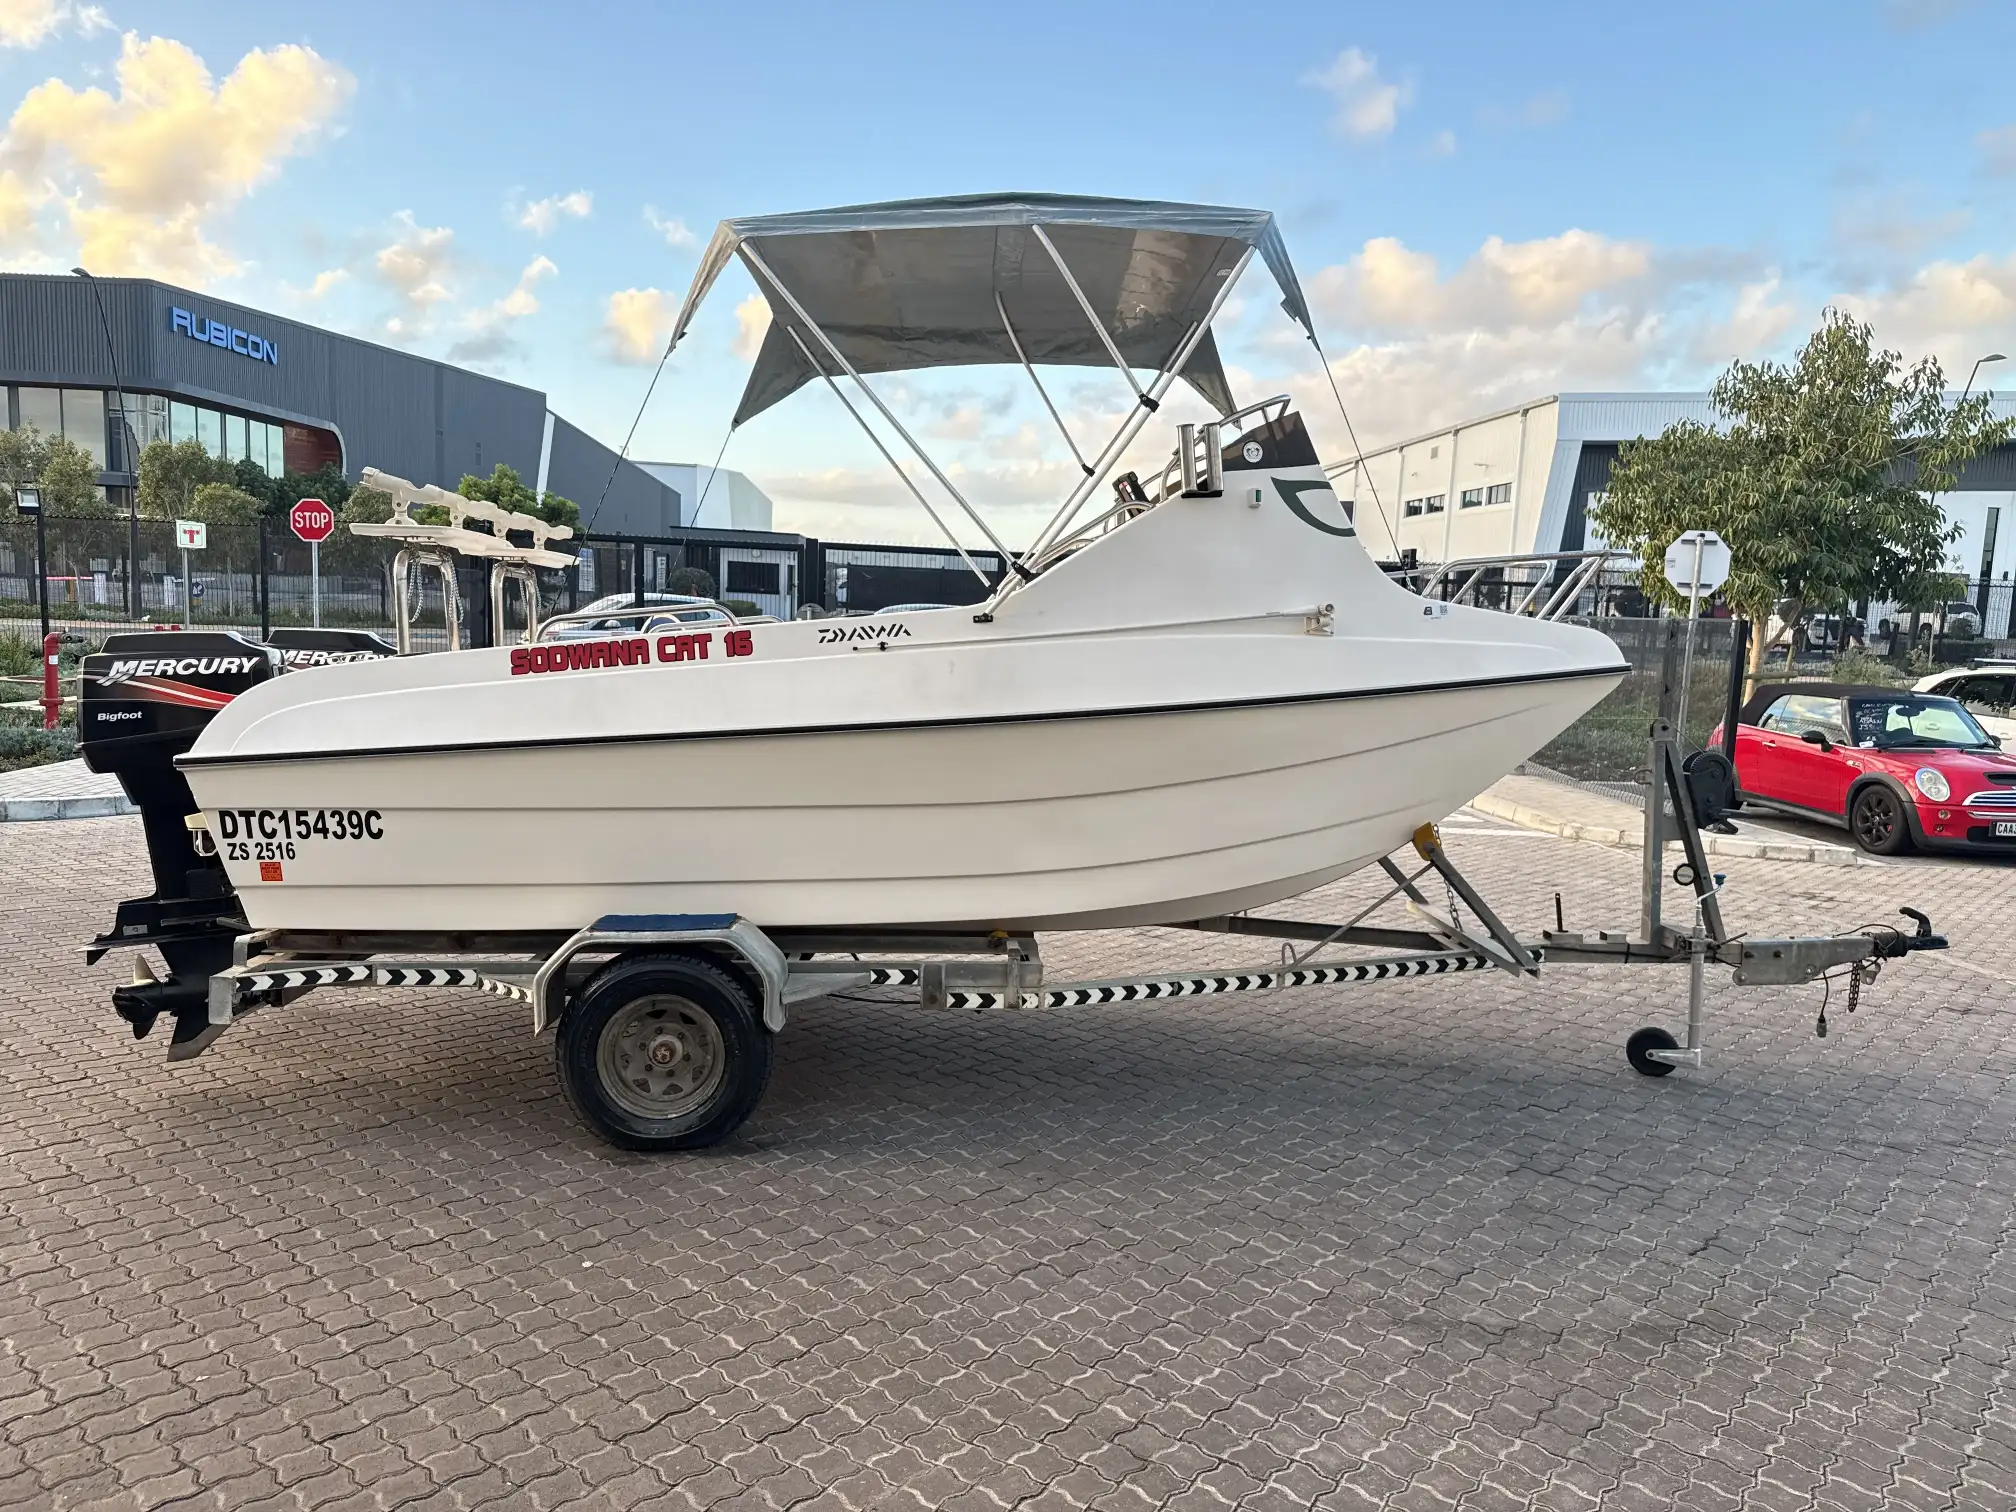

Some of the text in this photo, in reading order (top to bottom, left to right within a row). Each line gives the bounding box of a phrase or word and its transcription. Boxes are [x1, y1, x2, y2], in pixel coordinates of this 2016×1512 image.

[171, 306, 278, 365] RUBICON
[294, 512, 330, 529] STOP
[817, 623, 912, 644] DAIWA
[510, 630, 754, 676] SODWANA CAT 16
[104, 657, 262, 679] MERCURY
[97, 710, 143, 722] Bigfoot
[217, 809, 384, 840] DTC15439C
[226, 841, 296, 861] ZS 2516
